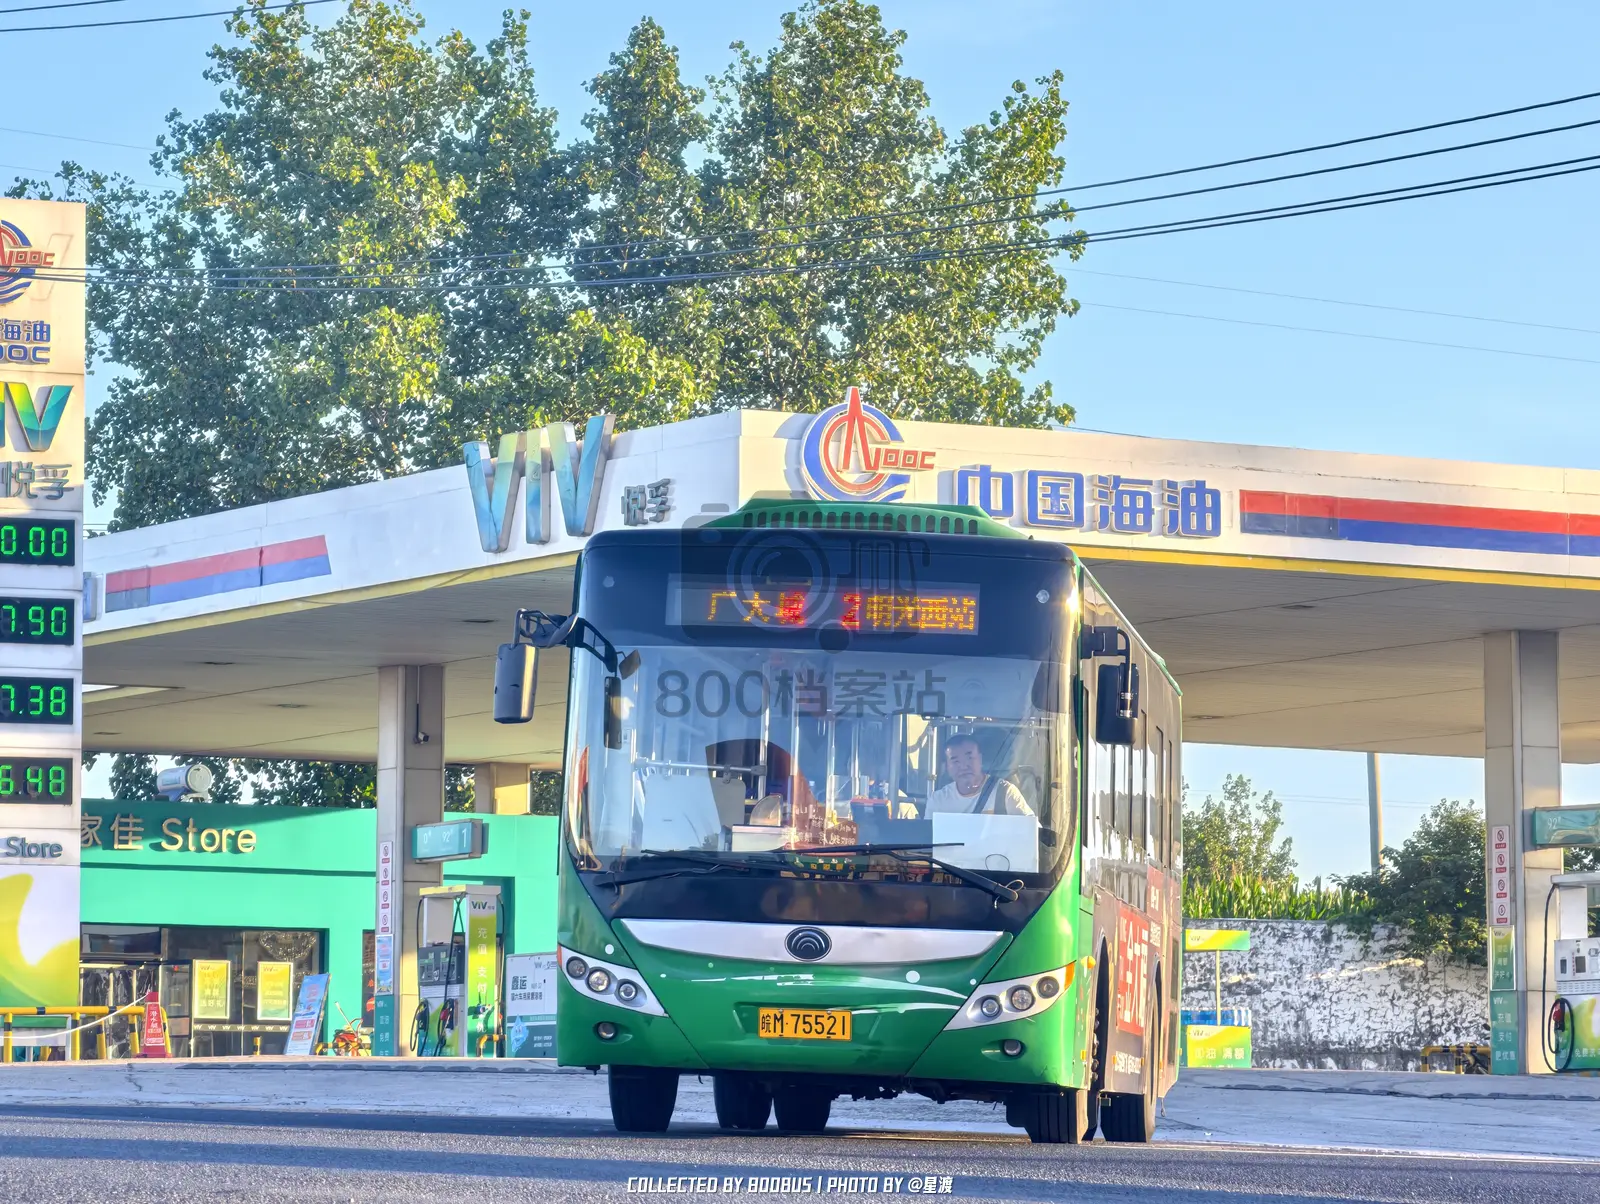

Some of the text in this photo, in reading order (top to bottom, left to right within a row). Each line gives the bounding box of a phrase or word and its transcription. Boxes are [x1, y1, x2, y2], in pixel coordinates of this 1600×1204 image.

[0, 345, 50, 363] OC
[1, 460, 74, 500] 悦孚
[464, 413, 615, 553] VIV
[621, 478, 671, 526] 悦孚
[955, 464, 1222, 538] 中国海油
[1, 605, 66, 637] 7.90
[1, 684, 65, 716] 7.38
[0, 766, 65, 796] 6.48
[6, 836, 63, 858] Store
[160, 817, 257, 853] Store
